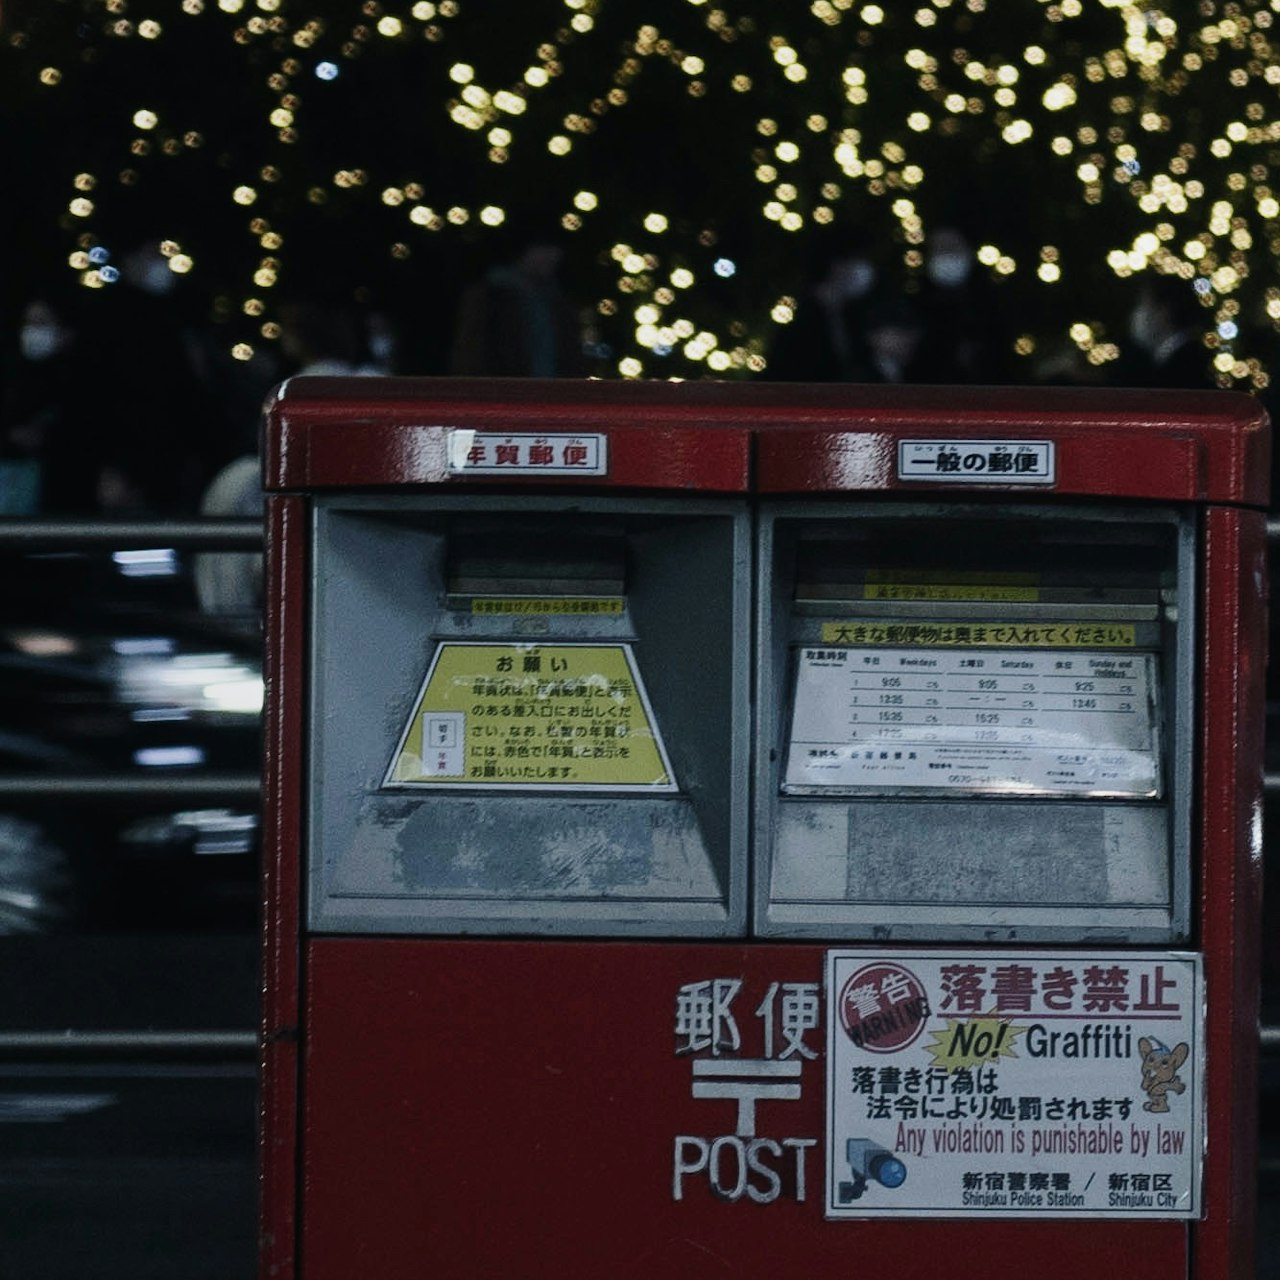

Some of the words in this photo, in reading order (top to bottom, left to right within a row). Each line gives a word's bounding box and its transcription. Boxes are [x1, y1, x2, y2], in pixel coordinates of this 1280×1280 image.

[467, 445, 588, 466] 年賀郵便
[911, 452, 1039, 473] 一般の郵便
[834, 624, 1134, 645] 大きな郵便物は奥まで入れてください。
[495, 656, 568, 673] お願い
[1001, 660, 1035, 670] Saturday
[1088, 659, 1116, 669] Sunday
[472, 705, 632, 719] のある差入口にお出しくだ
[471, 746, 630, 759] には、赤色で「年賀」と表示を
[471, 766, 578, 779] お願いいたします。
[848, 972, 912, 1019] 警告
[939, 964, 1180, 1012] 落書き禁止
[674, 977, 820, 1061] 郵便
[850, 997, 932, 1048] WARNING
[947, 1023, 1009, 1058] No!
[1026, 1024, 1132, 1059] Graffiti
[852, 1067, 1000, 1095] 落書き行為は
[866, 1095, 1134, 1121] 法令により処罰されます
[895, 1121, 927, 1157] Any
[933, 1122, 1004, 1154] violation
[1011, 1123, 1025, 1154] is
[1032, 1123, 1123, 1158] punishable
[1130, 1124, 1151, 1158] by
[1157, 1124, 1185, 1155] law
[672, 1134, 818, 1204] POST
[962, 1171, 1071, 1191] 新宿警察署
[1108, 1173, 1173, 1192] 新宿区
[962, 1191, 1008, 1208] Shinjuku
[1010, 1192, 1042, 1206] Police
[1046, 1192, 1085, 1207] Station
[1108, 1192, 1154, 1208] Shinjuku
[1156, 1192, 1179, 1208] City
